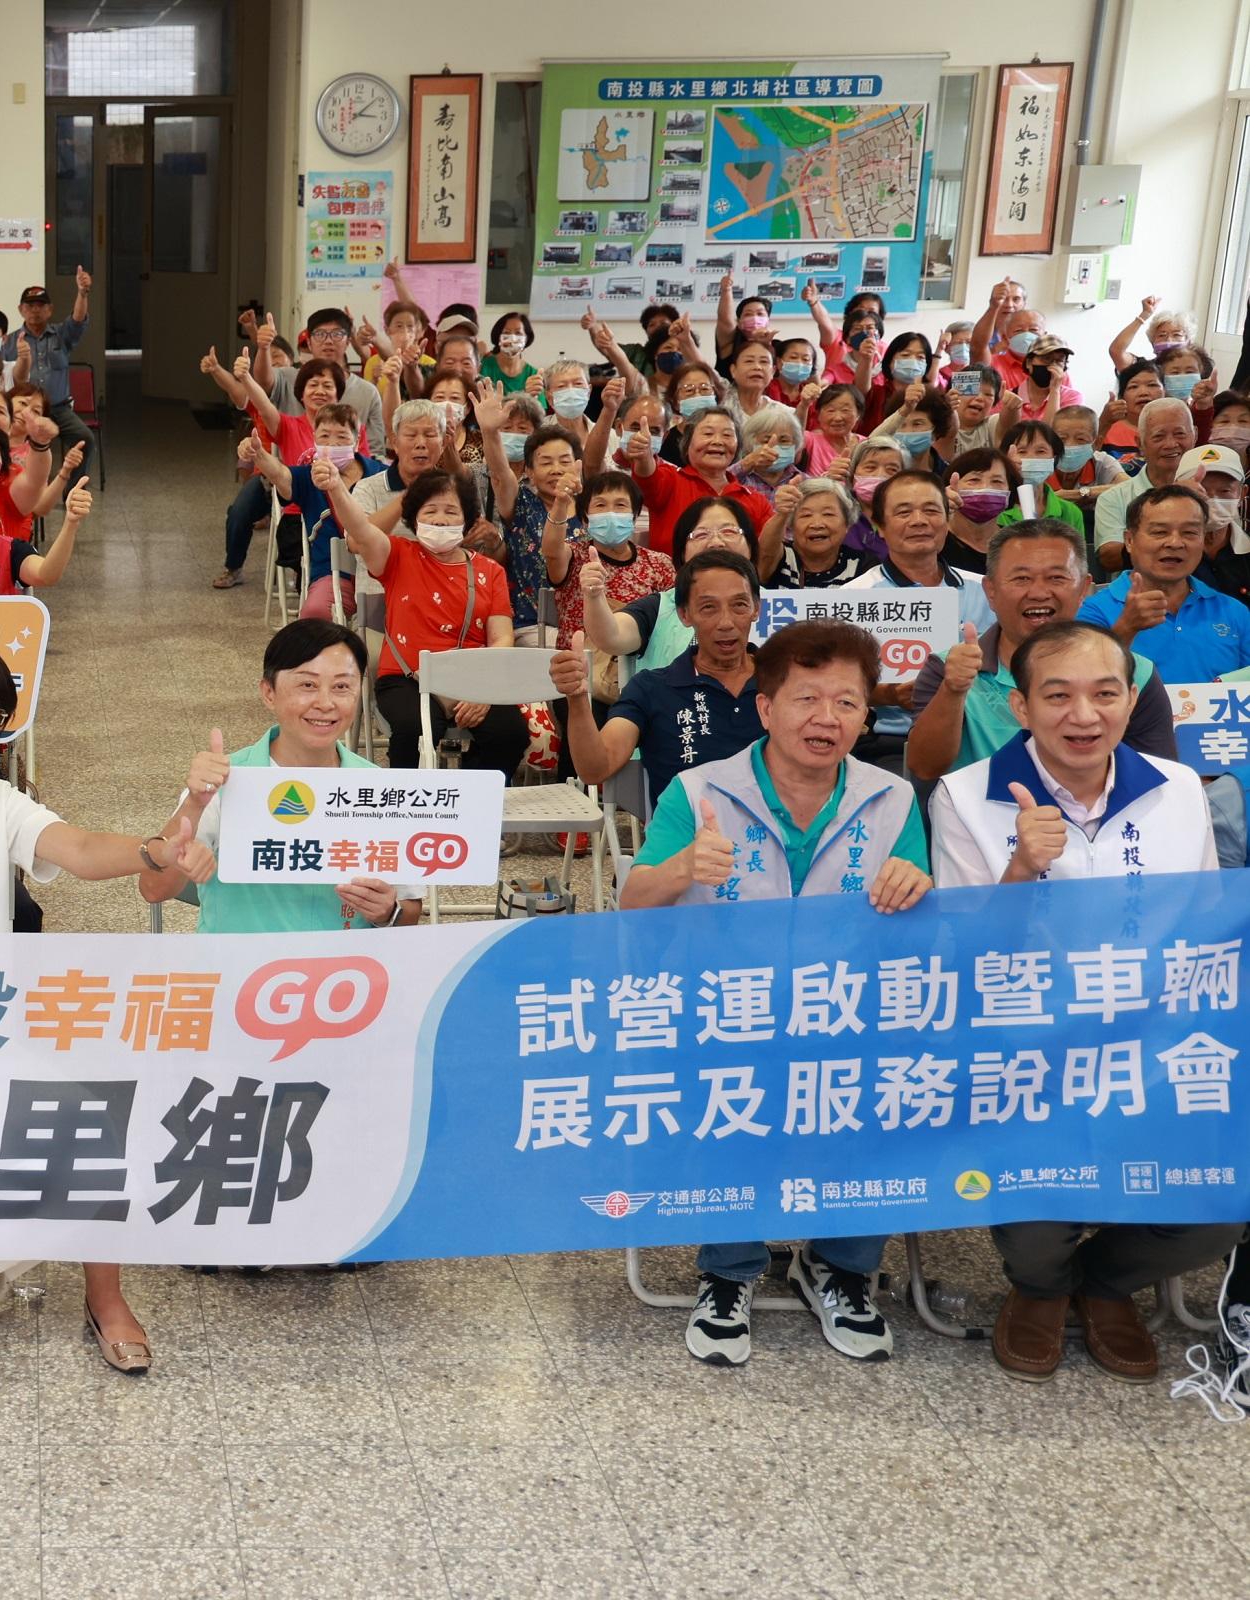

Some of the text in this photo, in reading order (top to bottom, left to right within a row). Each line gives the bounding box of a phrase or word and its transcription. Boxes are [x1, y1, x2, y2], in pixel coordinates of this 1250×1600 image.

[607, 79, 875, 98] 南投縣水里鄉北埔社區導覽圖
[805, 600, 933, 623] 南投縣政府
[876, 625, 933, 634] Government
[886, 643, 926, 664] GO
[693, 691, 712, 736] 新城村長
[1209, 689, 1250, 724] 水
[1199, 728, 1248, 766] 幸
[326, 786, 461, 809] 水里鄉公所
[351, 811, 384, 820] Township
[435, 812, 459, 820] County
[252, 838, 400, 873] 南投幸福
[413, 837, 462, 864] GO
[745, 822, 767, 873] 鄉長
[840, 819, 870, 893] 水里鄉
[254, 968, 366, 1021] GO
[514, 937, 1242, 1057] 試營運啟動暨車輛
[514, 1031, 1240, 1152] 展示及服務說明會
[998, 1165, 1099, 1185] 水里鄉公所
[1164, 1166, 1236, 1186] 總達客運
[657, 1186, 756, 1206] 交通部公路局
[822, 1177, 927, 1200] 南投縣政府
[657, 1202, 755, 1216] Highway Bureau, MOTC
[822, 1201, 850, 1209] Nantou
[880, 1196, 928, 1206] Government
